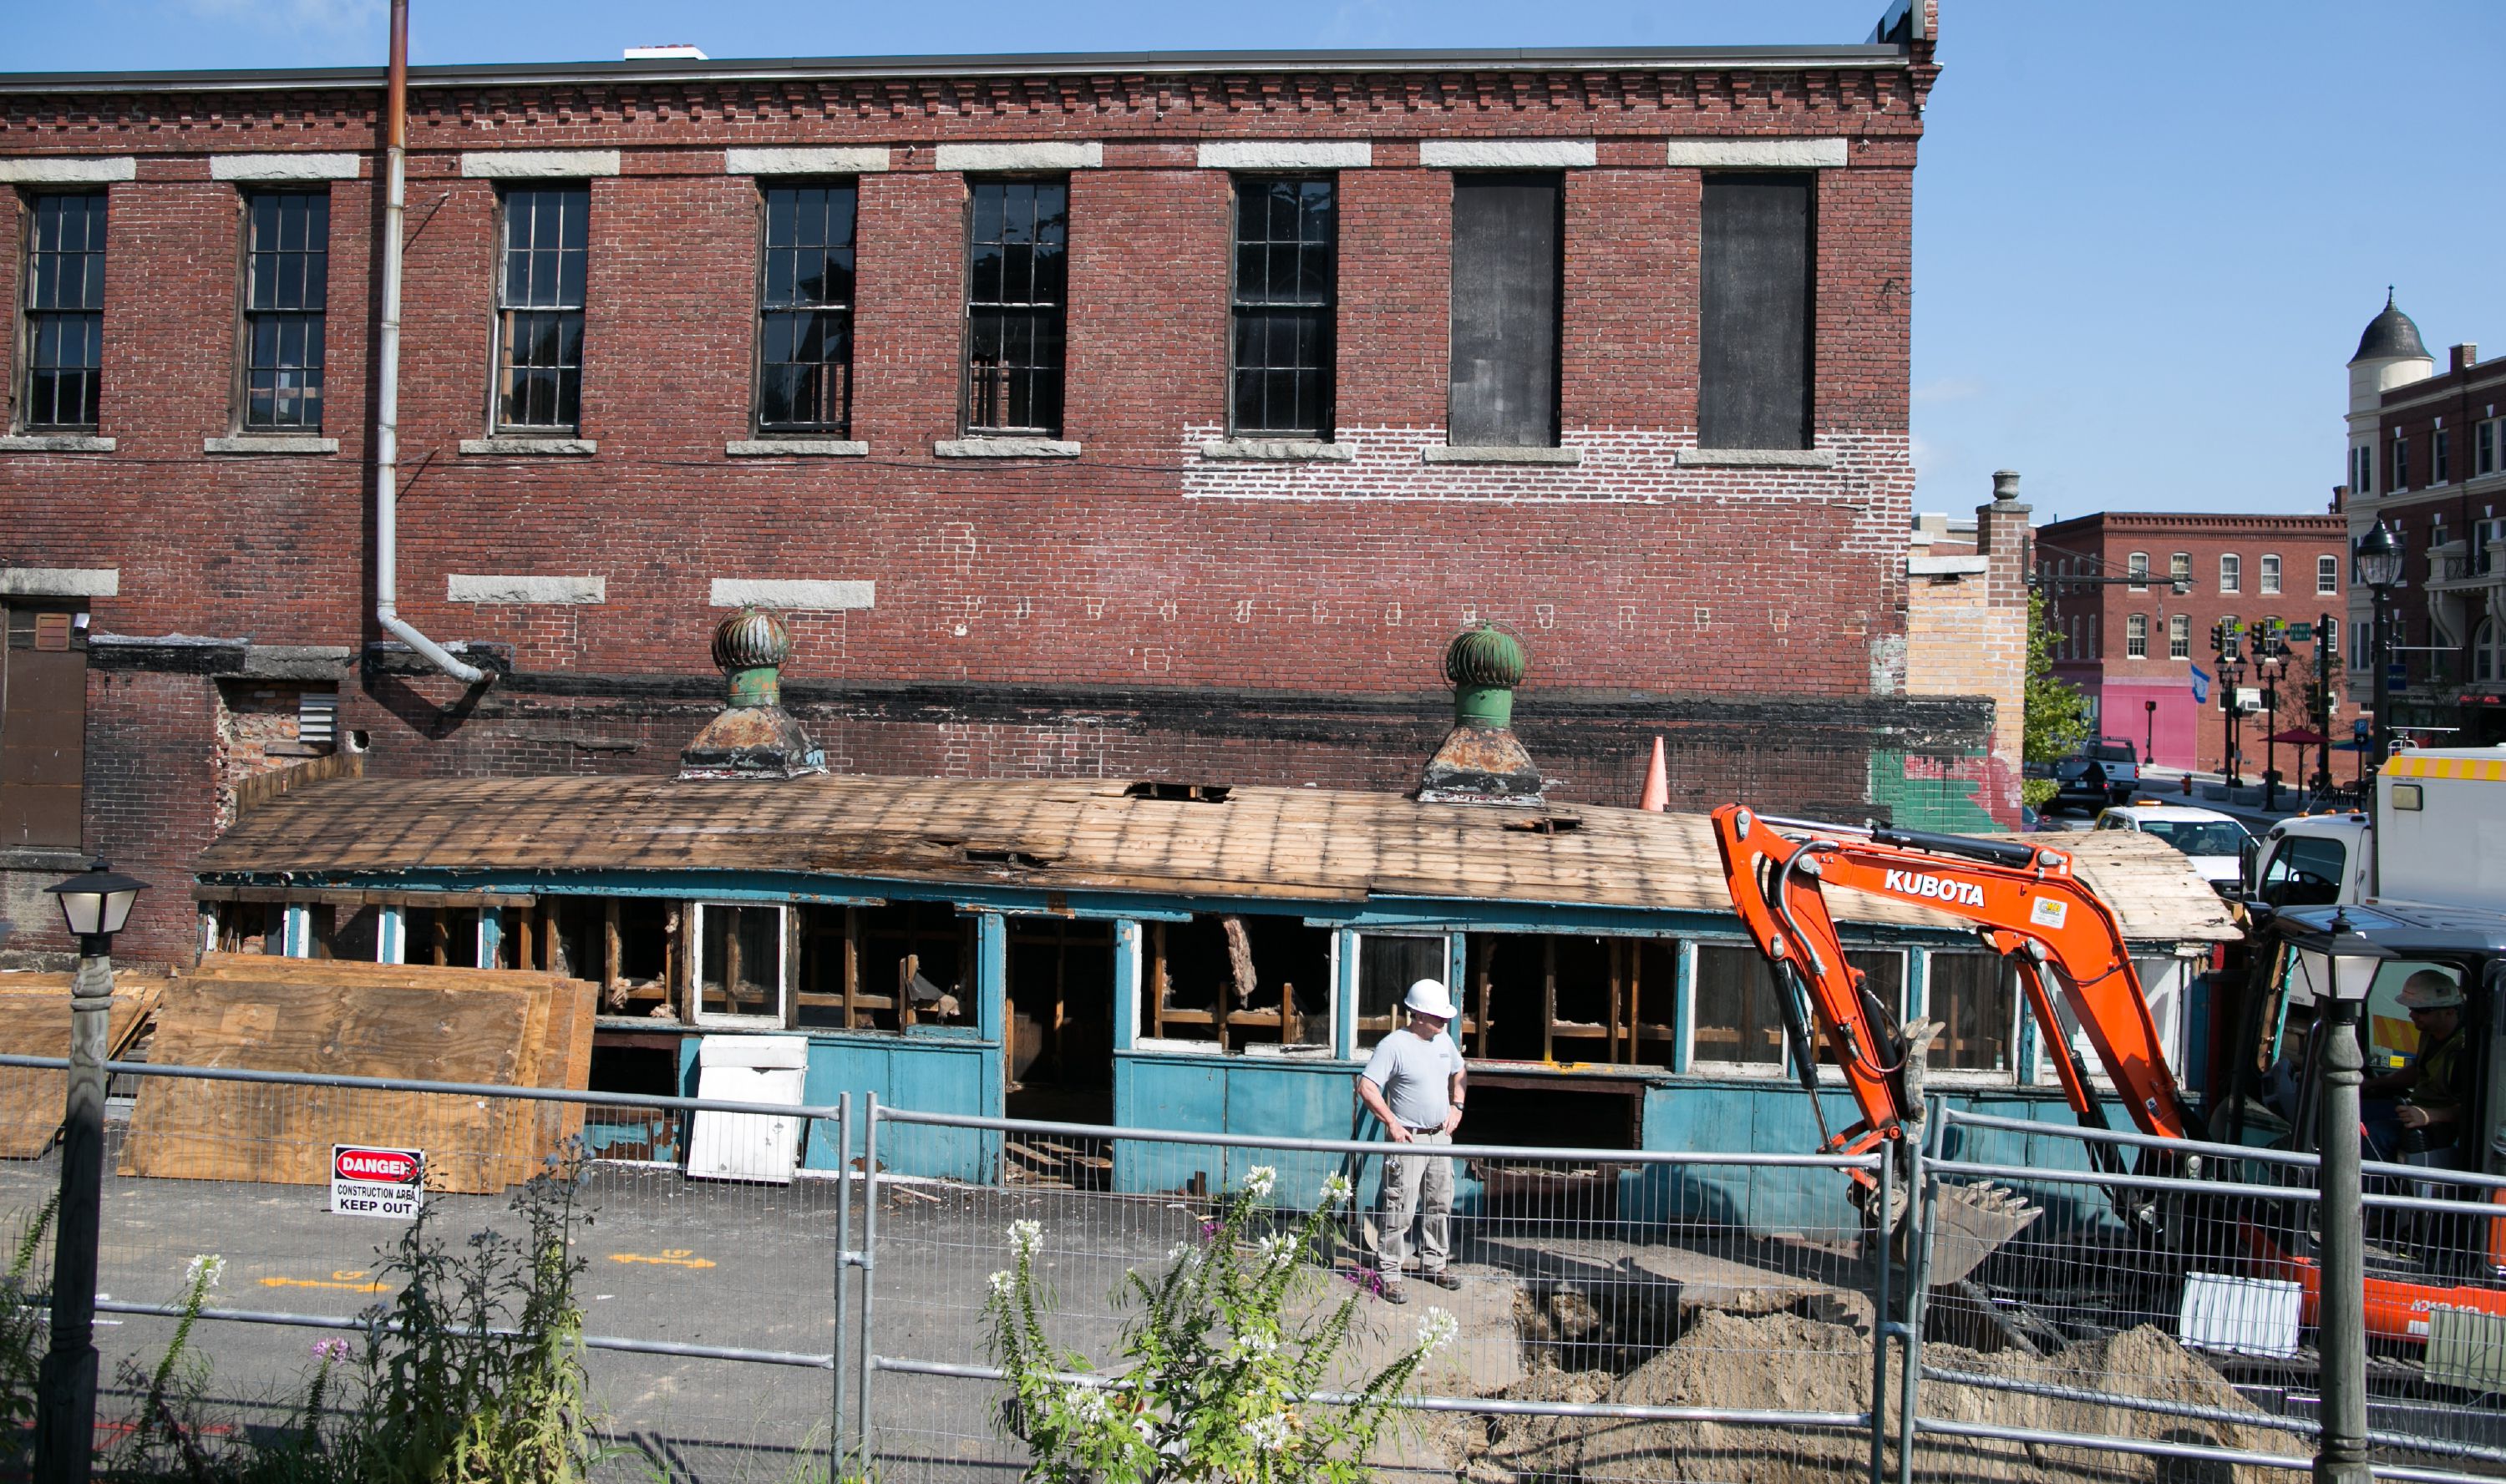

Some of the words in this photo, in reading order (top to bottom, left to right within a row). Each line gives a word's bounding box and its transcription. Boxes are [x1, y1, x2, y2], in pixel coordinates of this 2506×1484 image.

[1885, 869, 1985, 907] KUBOTA
[342, 1157, 410, 1175] DANGER
[337, 1185, 393, 1198] CONSTRUCTION
[396, 1188, 416, 1201] AREA
[340, 1198, 378, 1212] KEEP
[383, 1203, 412, 1214] OUT
